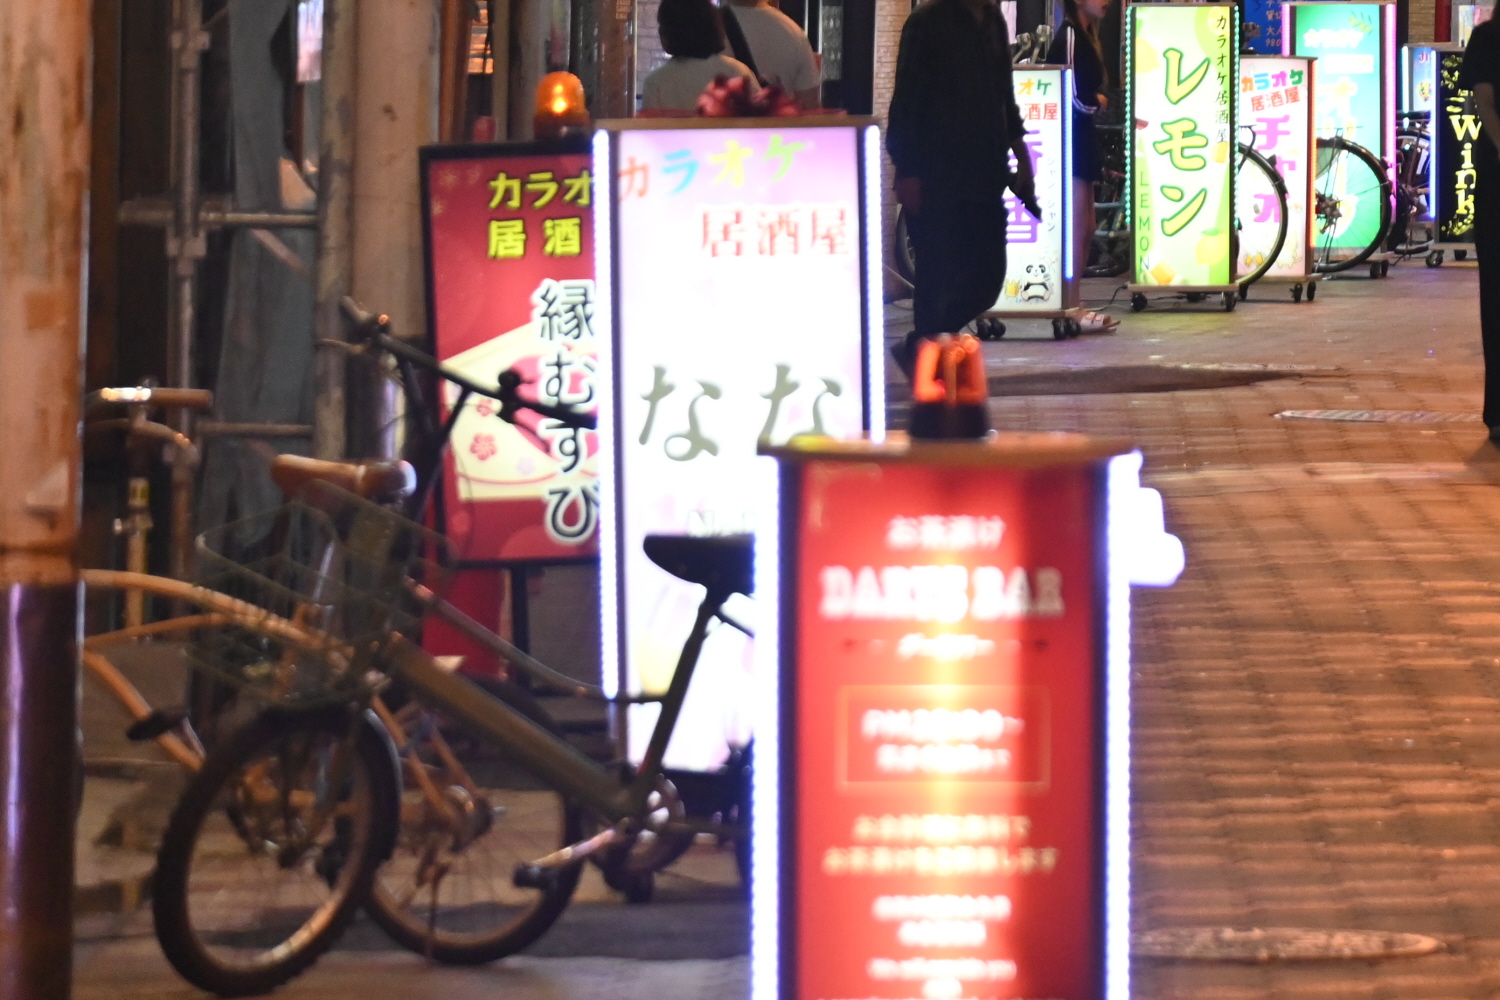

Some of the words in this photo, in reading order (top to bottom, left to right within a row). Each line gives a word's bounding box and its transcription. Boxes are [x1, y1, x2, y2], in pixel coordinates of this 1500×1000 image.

[1018, 78, 1053, 95] オケ
[1215, 15, 1229, 143] カラオケ居酒屋
[1241, 69, 1304, 93] カラオケ
[1251, 86, 1300, 112] 居酒屋
[1022, 102, 1058, 121] 酒屋
[1153, 47, 1211, 237] レモン
[617, 134, 805, 198] カラオケ
[488, 171, 593, 210] カラオ
[488, 218, 581, 258] 居酒
[702, 206, 849, 258] 居酒屋
[637, 363, 843, 462] なな
